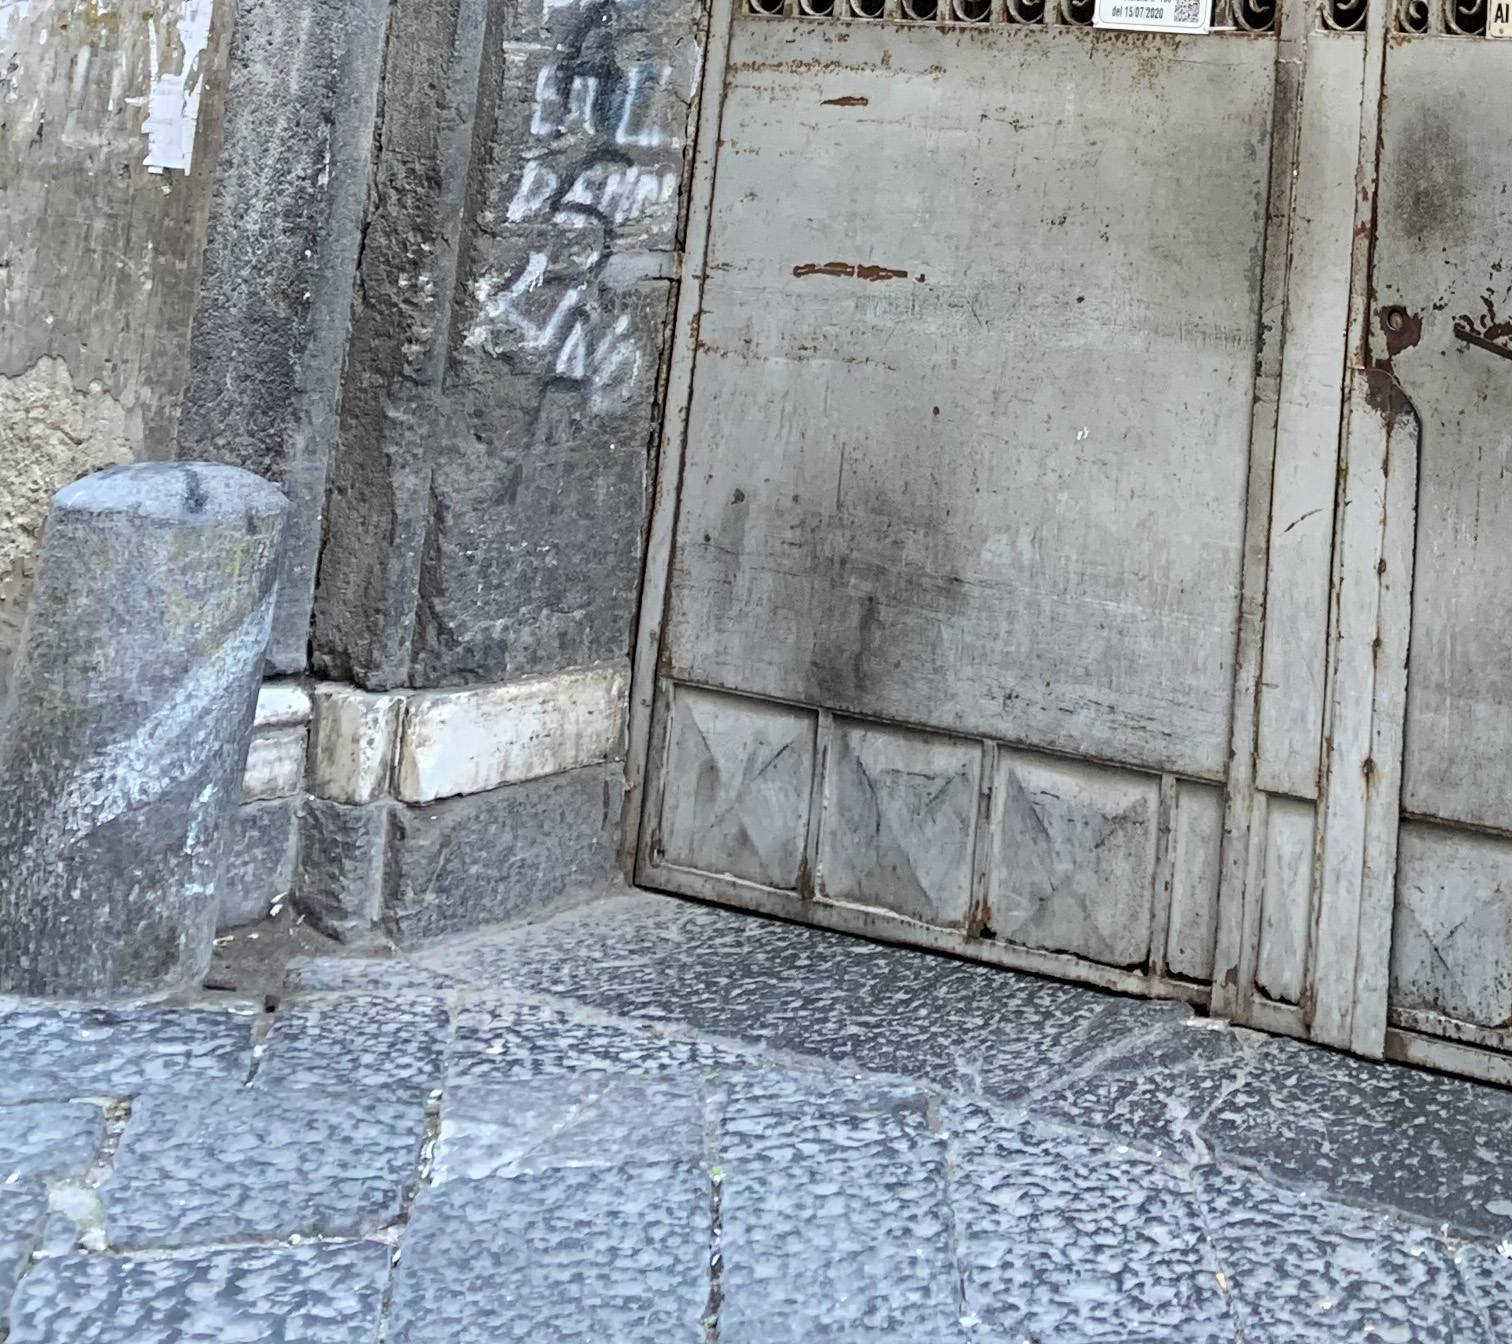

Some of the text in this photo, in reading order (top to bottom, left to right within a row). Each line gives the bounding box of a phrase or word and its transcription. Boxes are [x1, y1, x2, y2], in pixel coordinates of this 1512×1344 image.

[1111, 5, 1164, 20] del 15/07/2020
[1494, 3, 1510, 24] AI
